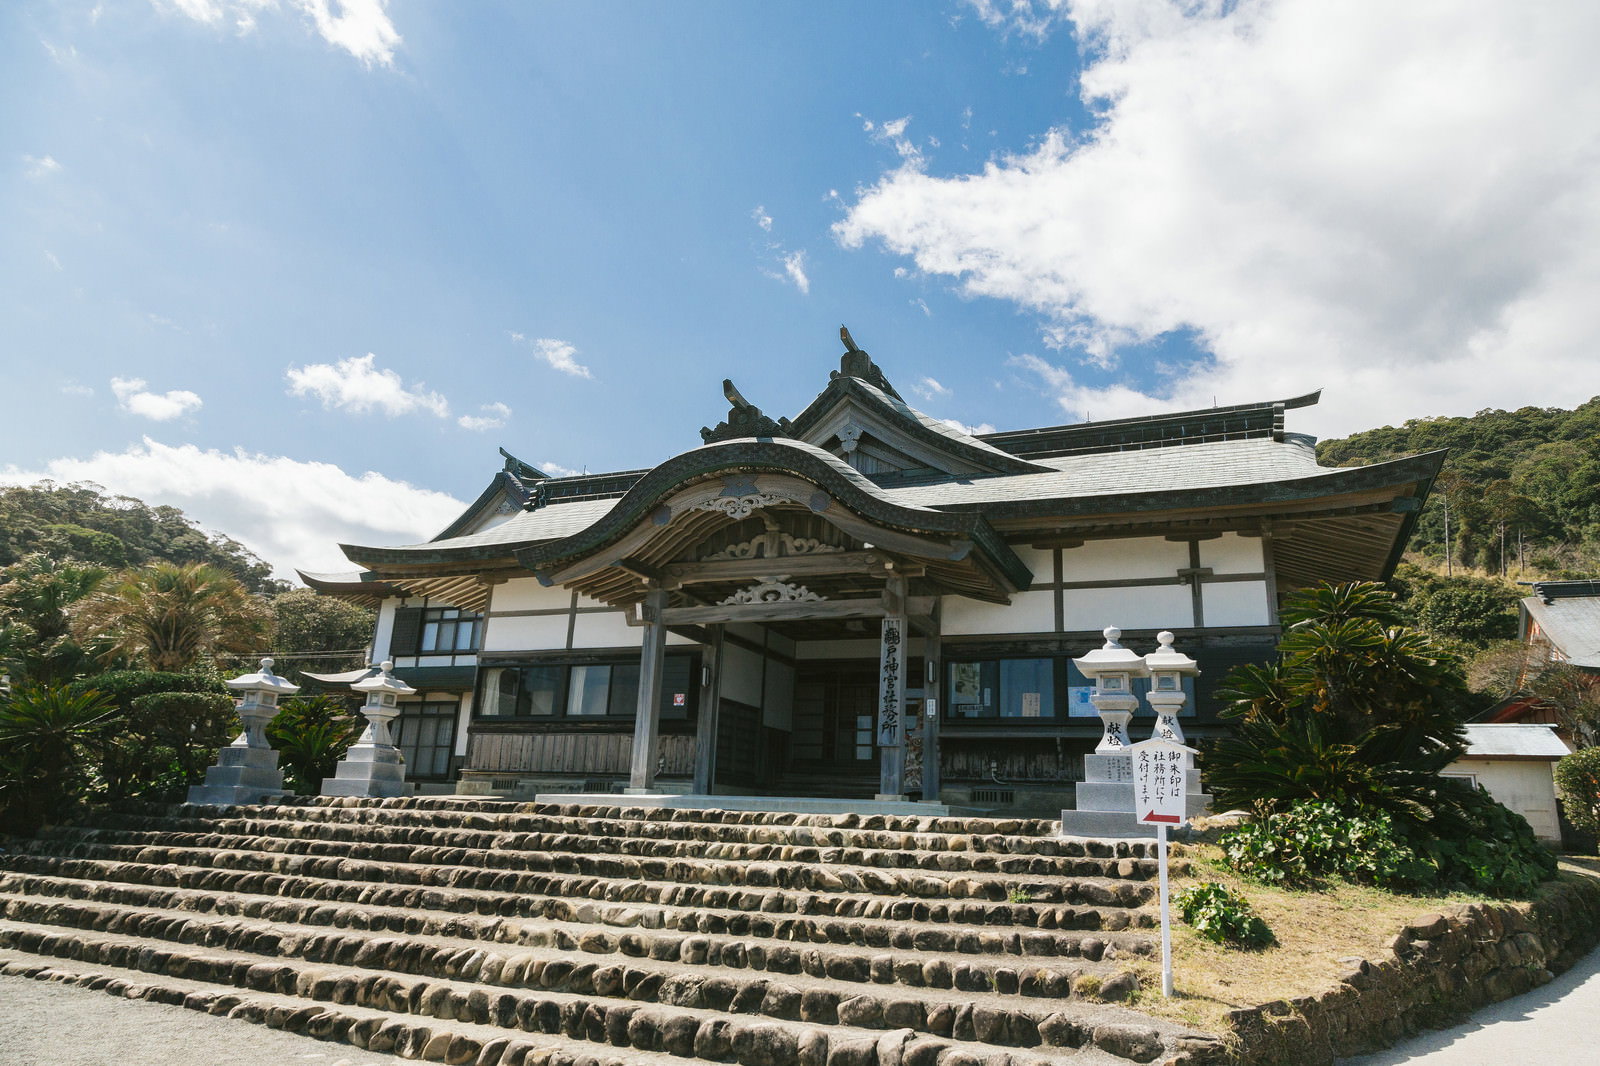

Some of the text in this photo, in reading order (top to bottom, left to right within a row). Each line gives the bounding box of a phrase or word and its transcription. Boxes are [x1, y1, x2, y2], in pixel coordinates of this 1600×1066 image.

[1138, 751, 1151, 804] 受付けます
[1153, 751, 1166, 804] 社務所にて
[1168, 751, 1182, 798] 御朱印は
